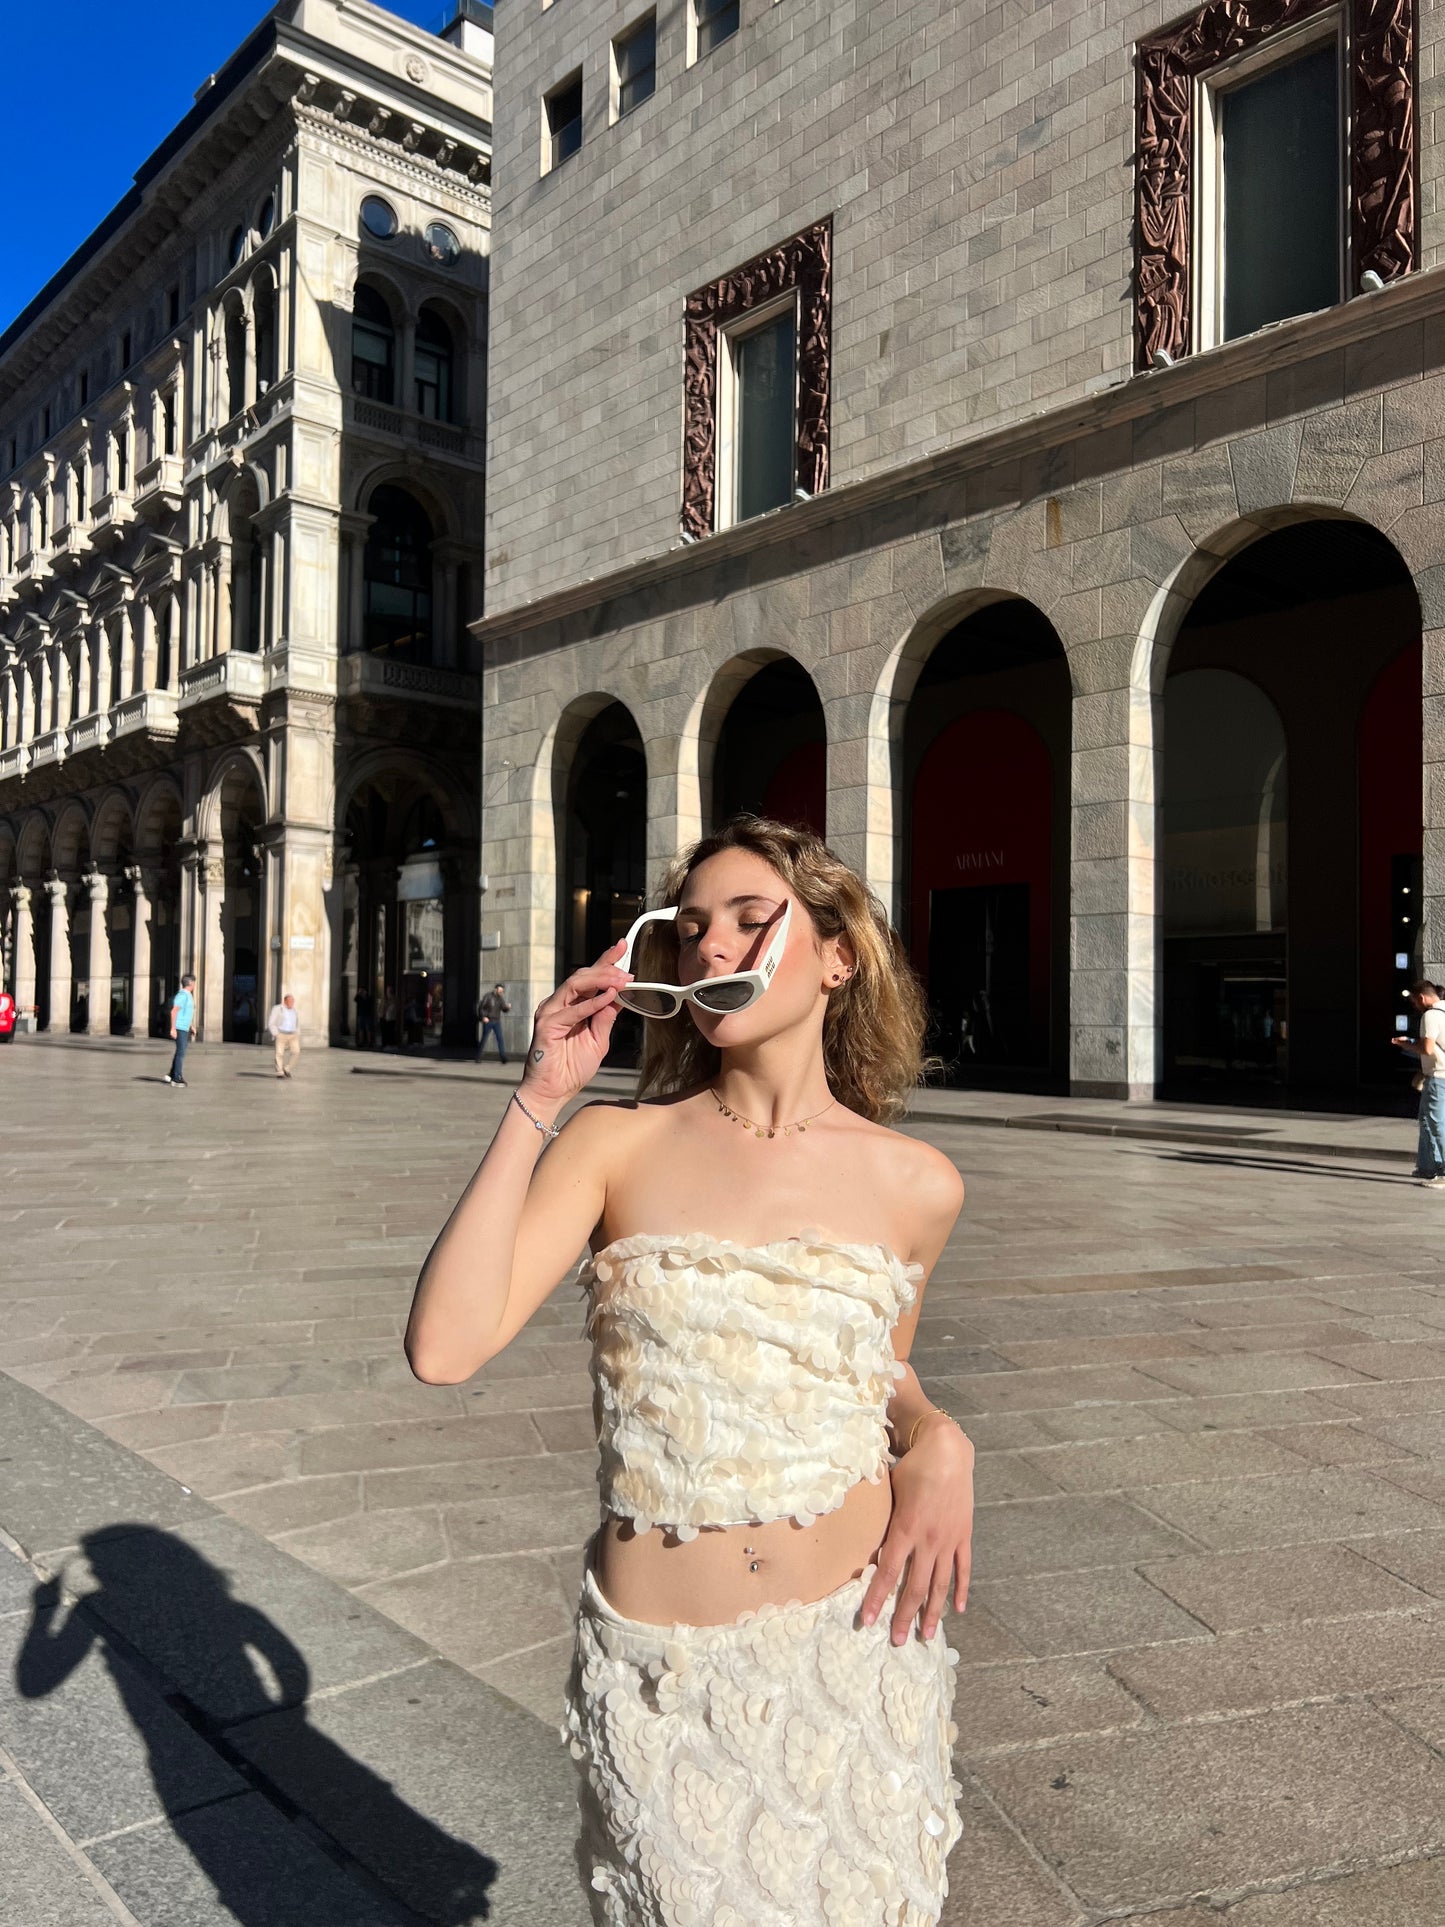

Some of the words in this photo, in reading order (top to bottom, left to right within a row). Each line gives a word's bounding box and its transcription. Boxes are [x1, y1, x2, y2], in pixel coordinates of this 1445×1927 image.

[953, 850, 1004, 870] ARMANI
[765, 956, 773, 972] MIU
[767, 962, 775, 979] MIU
